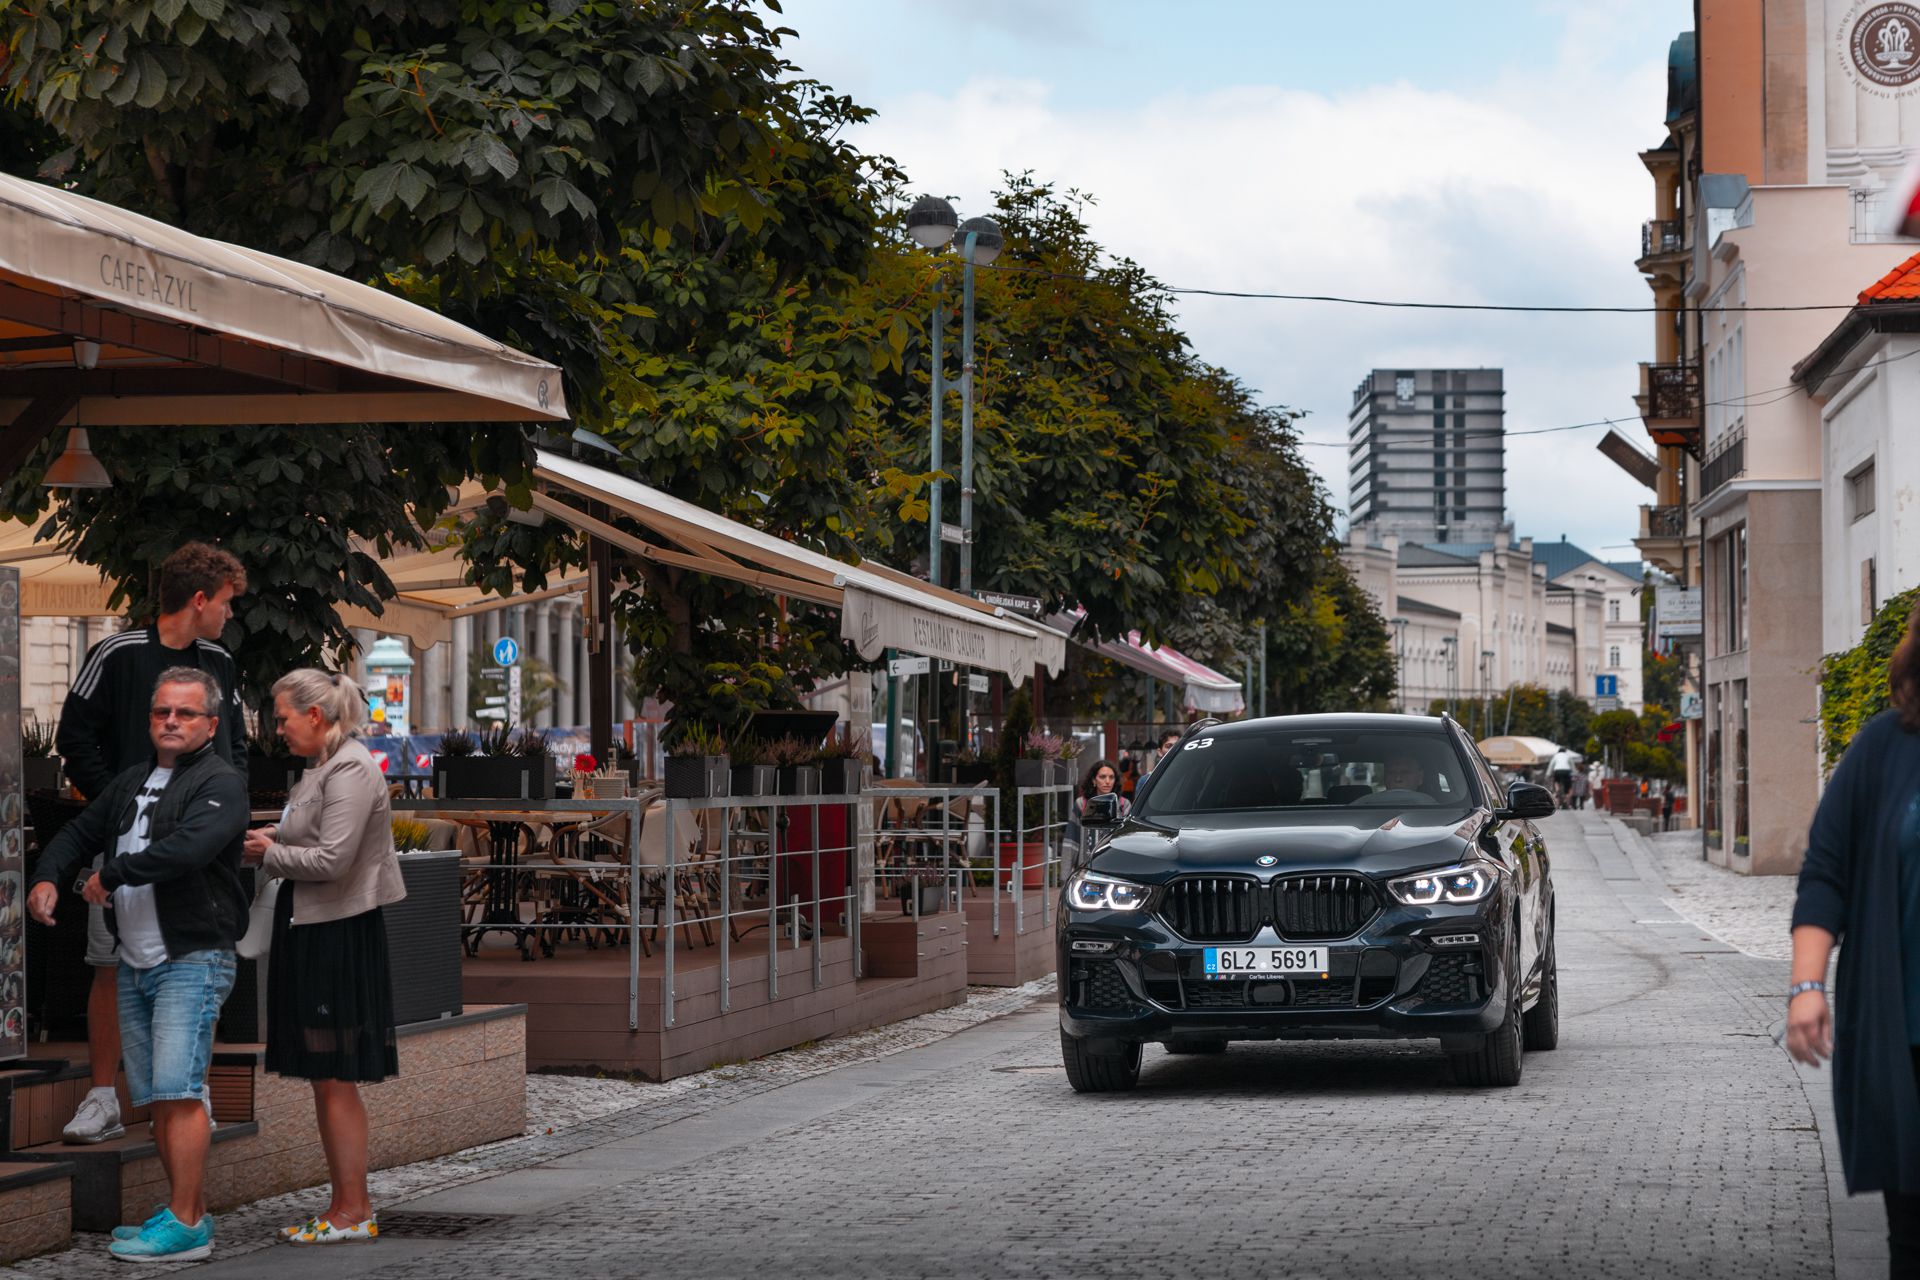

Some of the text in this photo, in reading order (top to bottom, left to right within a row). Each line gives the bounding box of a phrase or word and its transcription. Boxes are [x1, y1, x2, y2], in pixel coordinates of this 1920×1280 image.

[100, 254, 198, 312] CAFE AZYL
[1015, 599, 1029, 609] KAPLE
[913, 617, 986, 660] RESTAURANT SALVATOR
[917, 661, 928, 670] CITY
[1184, 738, 1214, 750] 63
[1221, 950, 1318, 970] 6L2 5691
